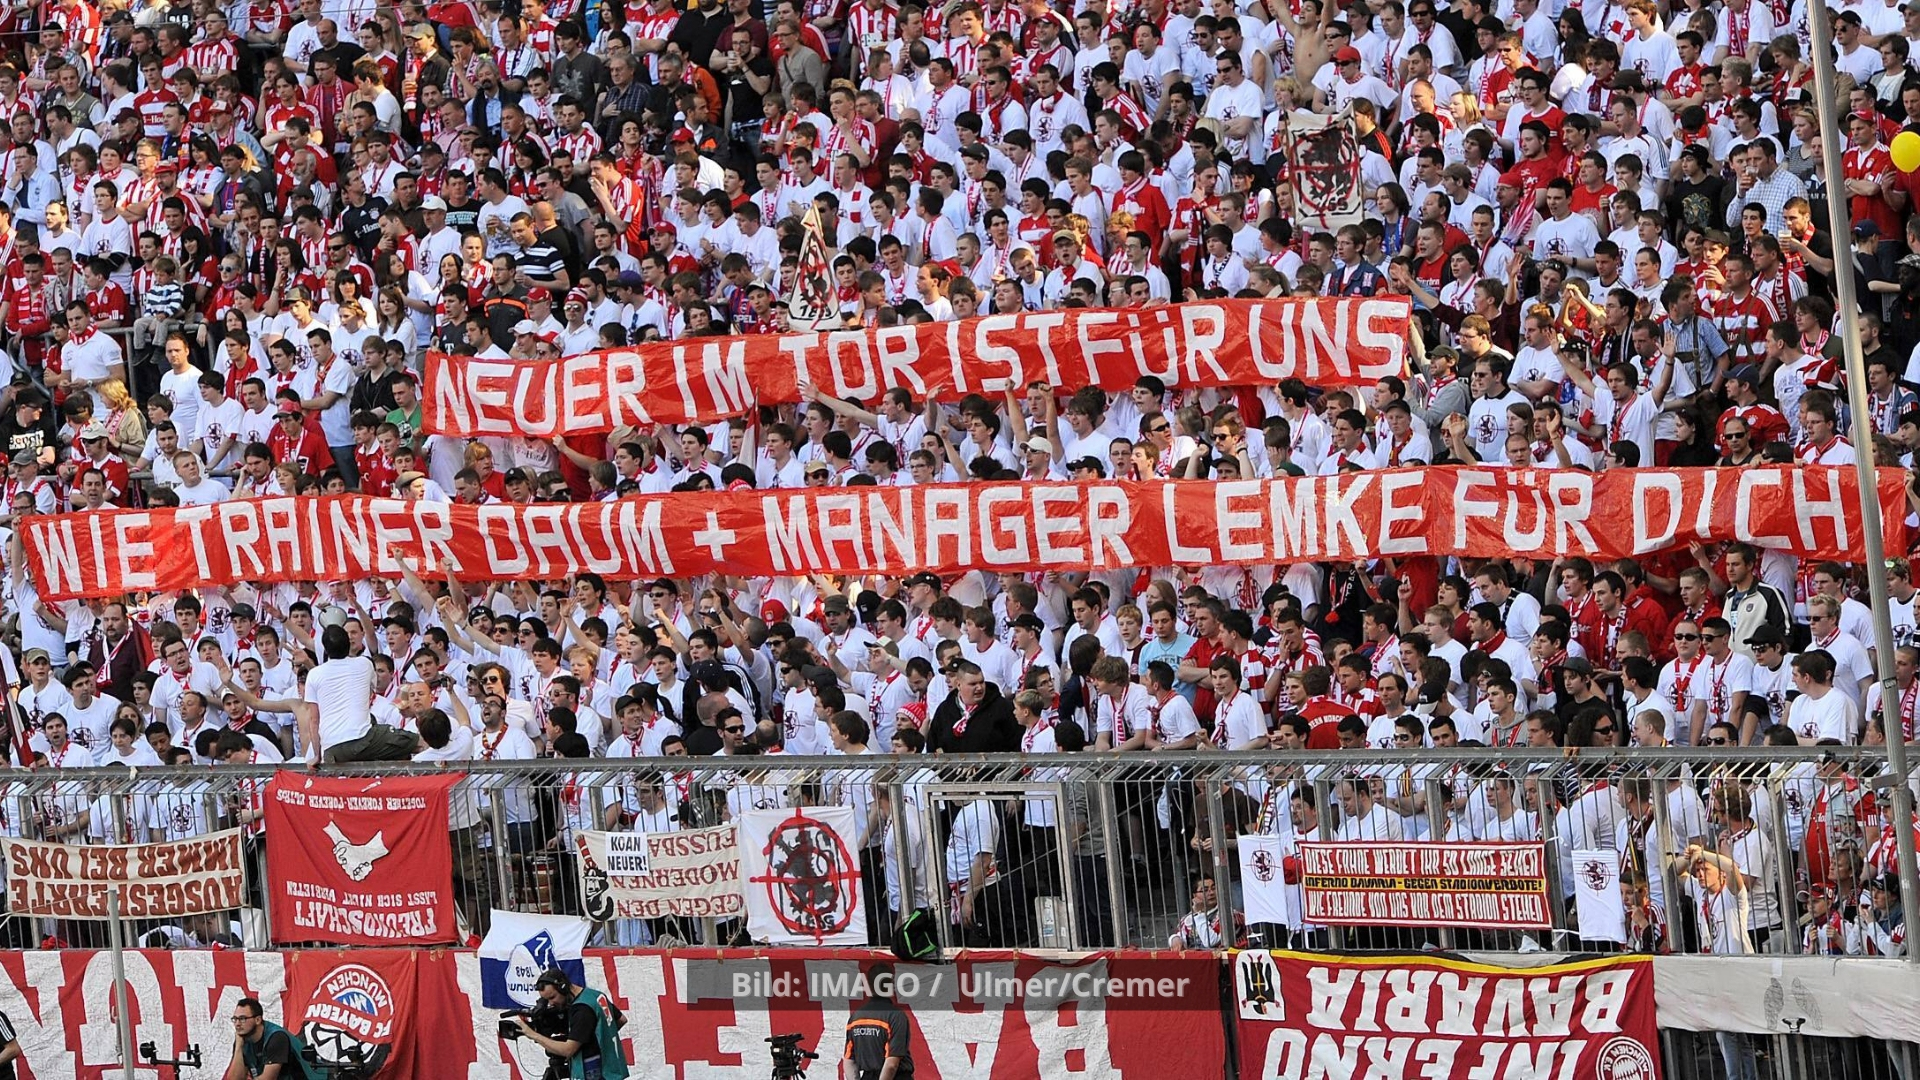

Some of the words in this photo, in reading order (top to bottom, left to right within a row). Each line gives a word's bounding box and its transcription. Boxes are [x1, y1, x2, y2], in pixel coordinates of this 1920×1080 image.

[733, 315, 757, 324] OPEL
[436, 352, 654, 433] NEUER
[672, 340, 757, 417] IM
[778, 324, 925, 400] TOR
[946, 312, 1065, 392] IST
[1077, 305, 1229, 386] FÜR
[1247, 300, 1410, 380] UNS
[30, 514, 156, 595] WIE
[174, 497, 463, 580] TRAINER
[477, 501, 676, 576] DAUM
[693, 510, 736, 562] +
[762, 486, 1134, 571] MANAGER
[1163, 471, 1428, 563] LEMKE
[1453, 470, 1599, 553] FÜR
[1632, 468, 1884, 555] DICH
[137, 834, 240, 878] IMMER
[610, 836, 641, 851] KOAN
[649, 827, 738, 858] FUSSBA
[9, 843, 73, 879] UNS
[79, 847, 128, 880] BEI
[607, 855, 647, 871] NEUER!
[611, 859, 740, 890] MODERNEN
[1305, 848, 1334, 875] DIESE
[1336, 848, 1370, 875] FAHNE
[1373, 849, 1417, 875] WERDET
[1420, 849, 1440, 875] IHR
[1443, 850, 1459, 876] SO
[1460, 850, 1496, 876] LANGE
[1500, 849, 1538, 876] SEHEN
[286, 880, 336, 902] VERBIETEN
[1305, 876, 1348, 888] INFERNO
[1350, 877, 1396, 889] BAVARIA
[1404, 877, 1438, 890] GEGEN
[377, 893, 403, 907] SICH
[617, 899, 660, 918] DEN
[669, 893, 745, 917] GEGEN
[1308, 890, 1325, 917] WIE
[1326, 891, 1367, 917] FREUNDE
[1368, 891, 1388, 918] VON
[1389, 892, 1408, 918] UNS
[1409, 893, 1430, 919] VOR
[1431, 893, 1454, 919] DEM
[1455, 894, 1499, 920] STADION
[1500, 894, 1543, 922] STEHEN
[294, 901, 437, 938] FREUNDSCHAFT
[509, 981, 539, 995] ochum
[1306, 967, 1635, 1037] BAVARIA
[305, 1004, 371, 1036] BAYERN
[373, 1020, 392, 1038] FC
[853, 1027, 880, 1037] SECURITY
